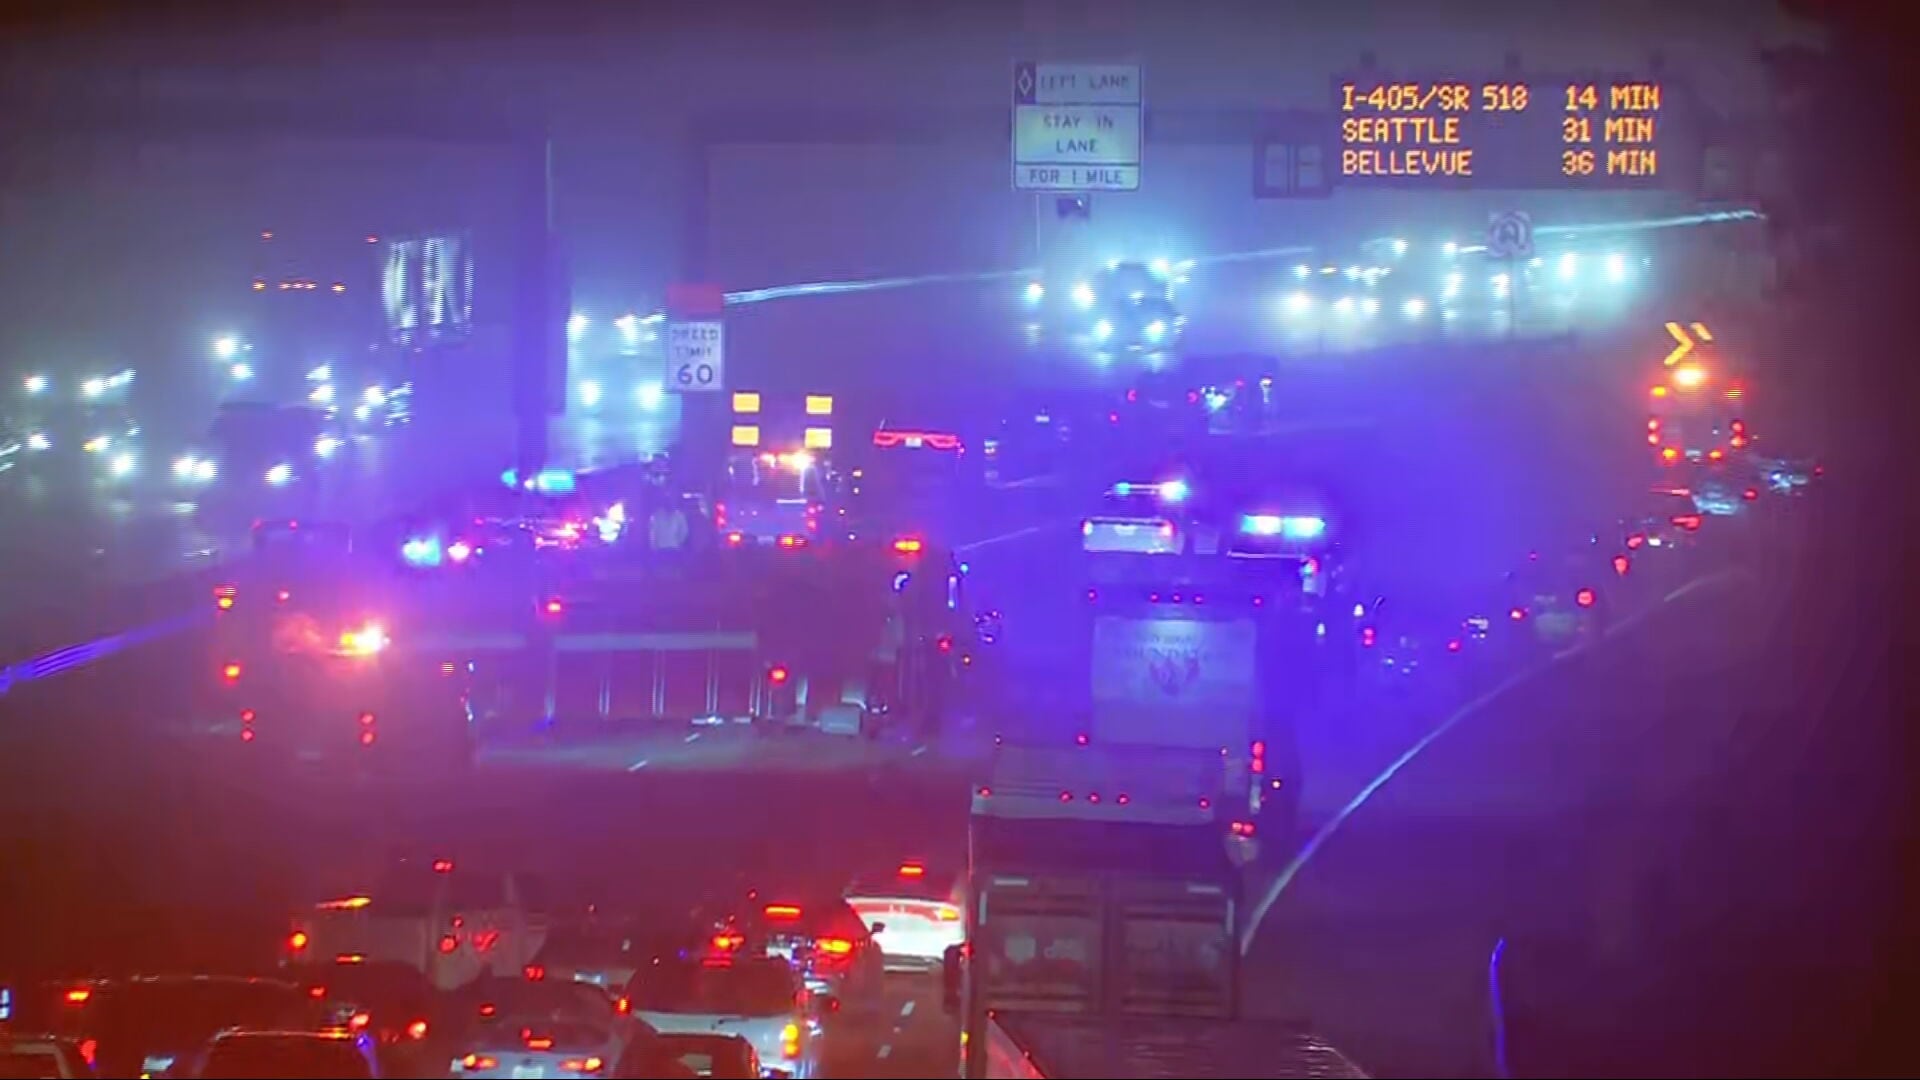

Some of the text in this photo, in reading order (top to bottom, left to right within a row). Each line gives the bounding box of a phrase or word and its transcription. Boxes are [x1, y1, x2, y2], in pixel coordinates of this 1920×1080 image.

[1342, 85, 1660, 111] I-405/SR 518 14 MIN
[1043, 115, 1113, 129] STAY IN
[1342, 117, 1653, 143] SEATTLE 31 MIN
[1056, 138, 1098, 153] LANE
[1342, 150, 1656, 175] BELLEVUE 36 MIN
[1029, 169, 1060, 184] FOR
[1086, 169, 1123, 184] MILE
[678, 364, 713, 384] 60
